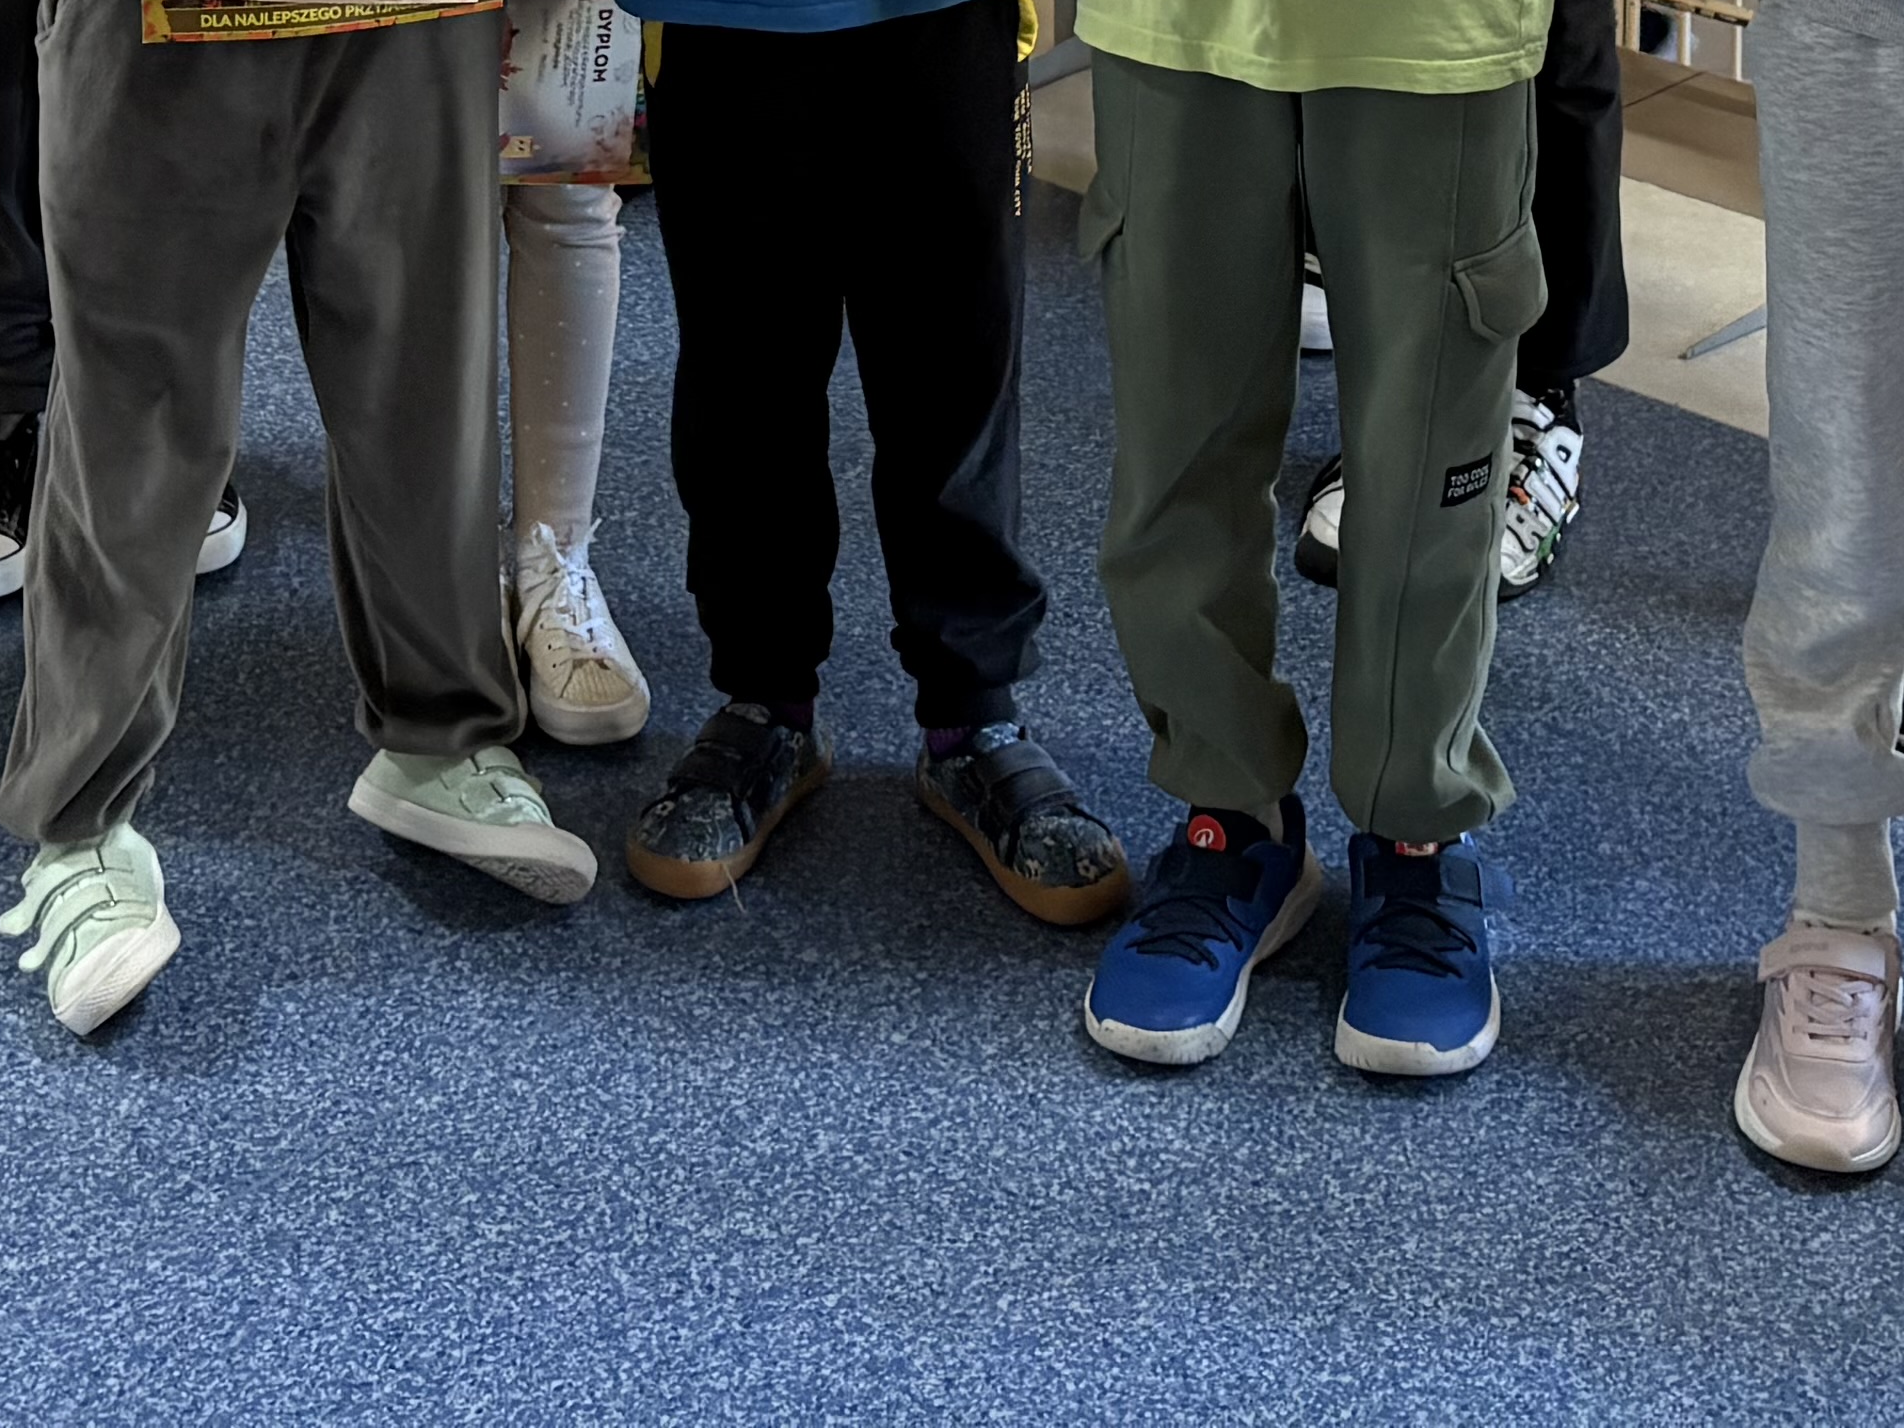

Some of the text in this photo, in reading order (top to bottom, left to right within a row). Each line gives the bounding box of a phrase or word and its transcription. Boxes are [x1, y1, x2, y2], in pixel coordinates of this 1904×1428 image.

[200, 7, 342, 28] DLA NAJLEPSZEGO
[593, 9, 613, 82] DYPLOM
